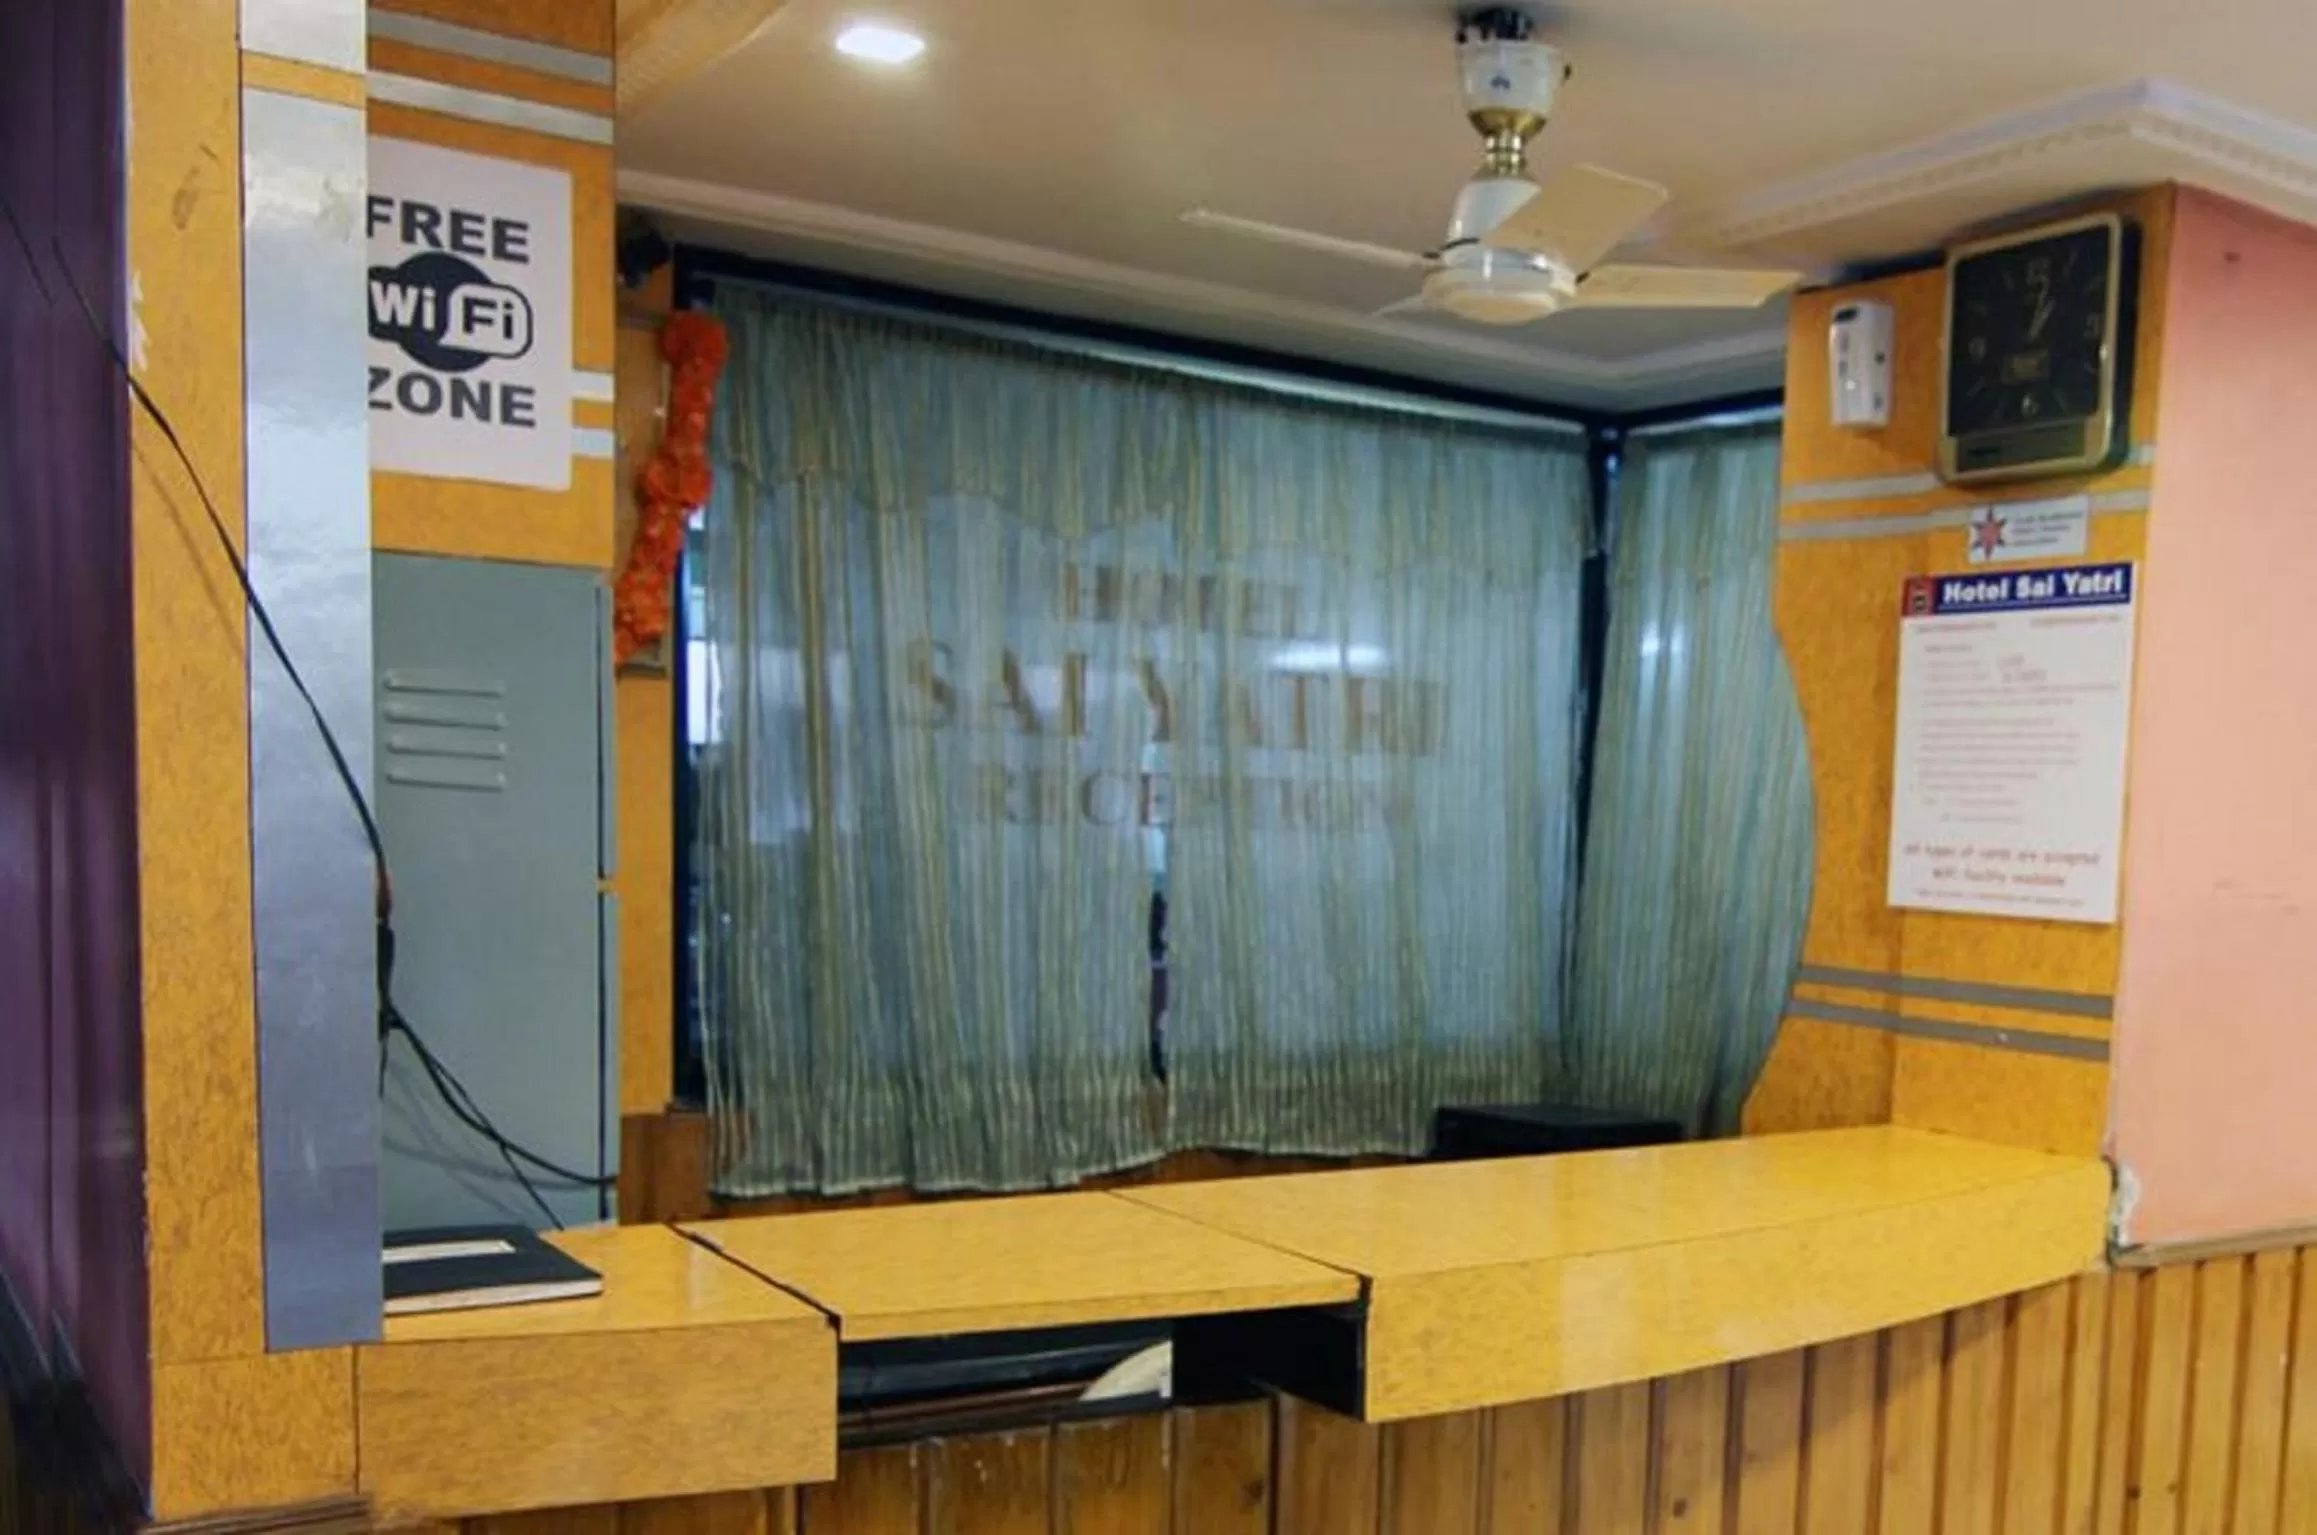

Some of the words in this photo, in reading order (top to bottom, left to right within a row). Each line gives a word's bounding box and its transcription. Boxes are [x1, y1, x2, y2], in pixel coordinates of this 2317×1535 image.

[367, 195, 530, 265] FREE
[368, 366, 537, 428] ZONE
[1943, 577, 2010, 604] Hotel
[2016, 573, 2055, 599] Sai
[2062, 568, 2123, 596] Yatri
